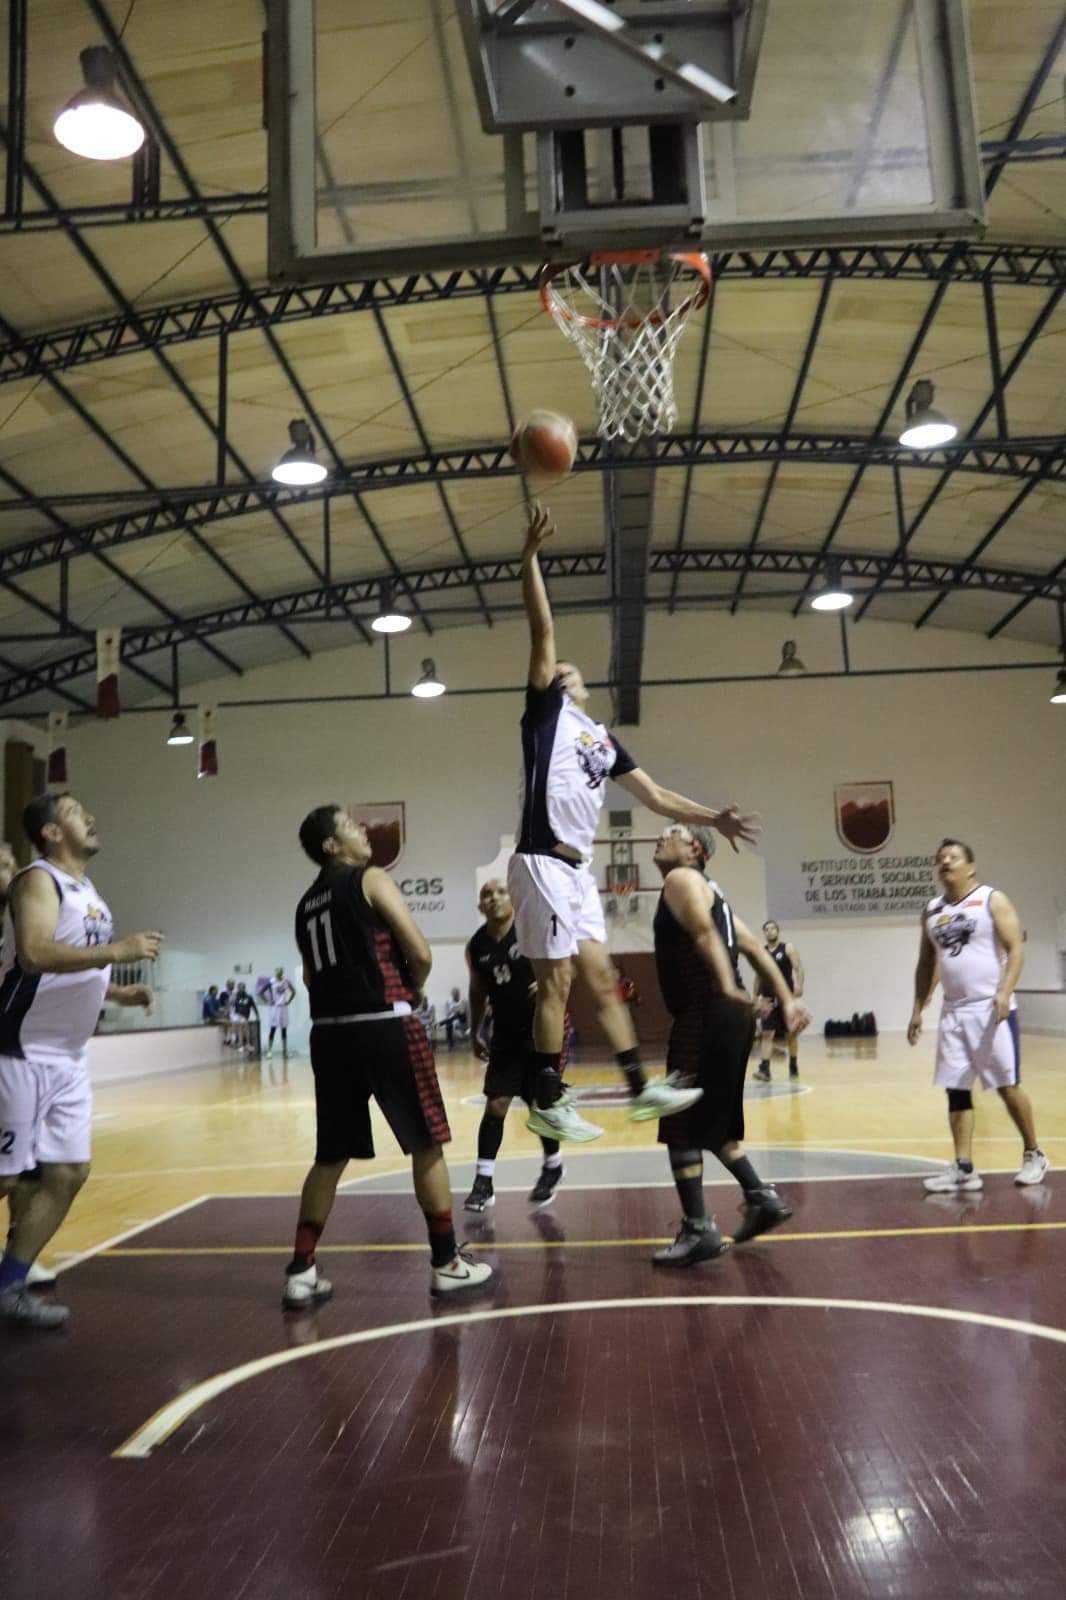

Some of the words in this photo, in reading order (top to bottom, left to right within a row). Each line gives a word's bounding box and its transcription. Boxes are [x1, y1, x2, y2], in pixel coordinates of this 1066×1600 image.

[801, 859, 857, 872] INSTITUTO
[860, 859, 874, 870] DE
[394, 877, 445, 896] cas
[808, 875, 815, 887] Y
[820, 872, 876, 886] SERVICIOS
[881, 870, 933, 882] SOCIALES
[805, 890, 820, 902] DE
[824, 888, 848, 902] LOS
[852, 885, 936, 898] TRABAJADORES
[406, 901, 447, 912] STADO
[550, 913, 558, 937] 1
[306, 908, 337, 972] 11
[0, 1128, 16, 1155] 2
